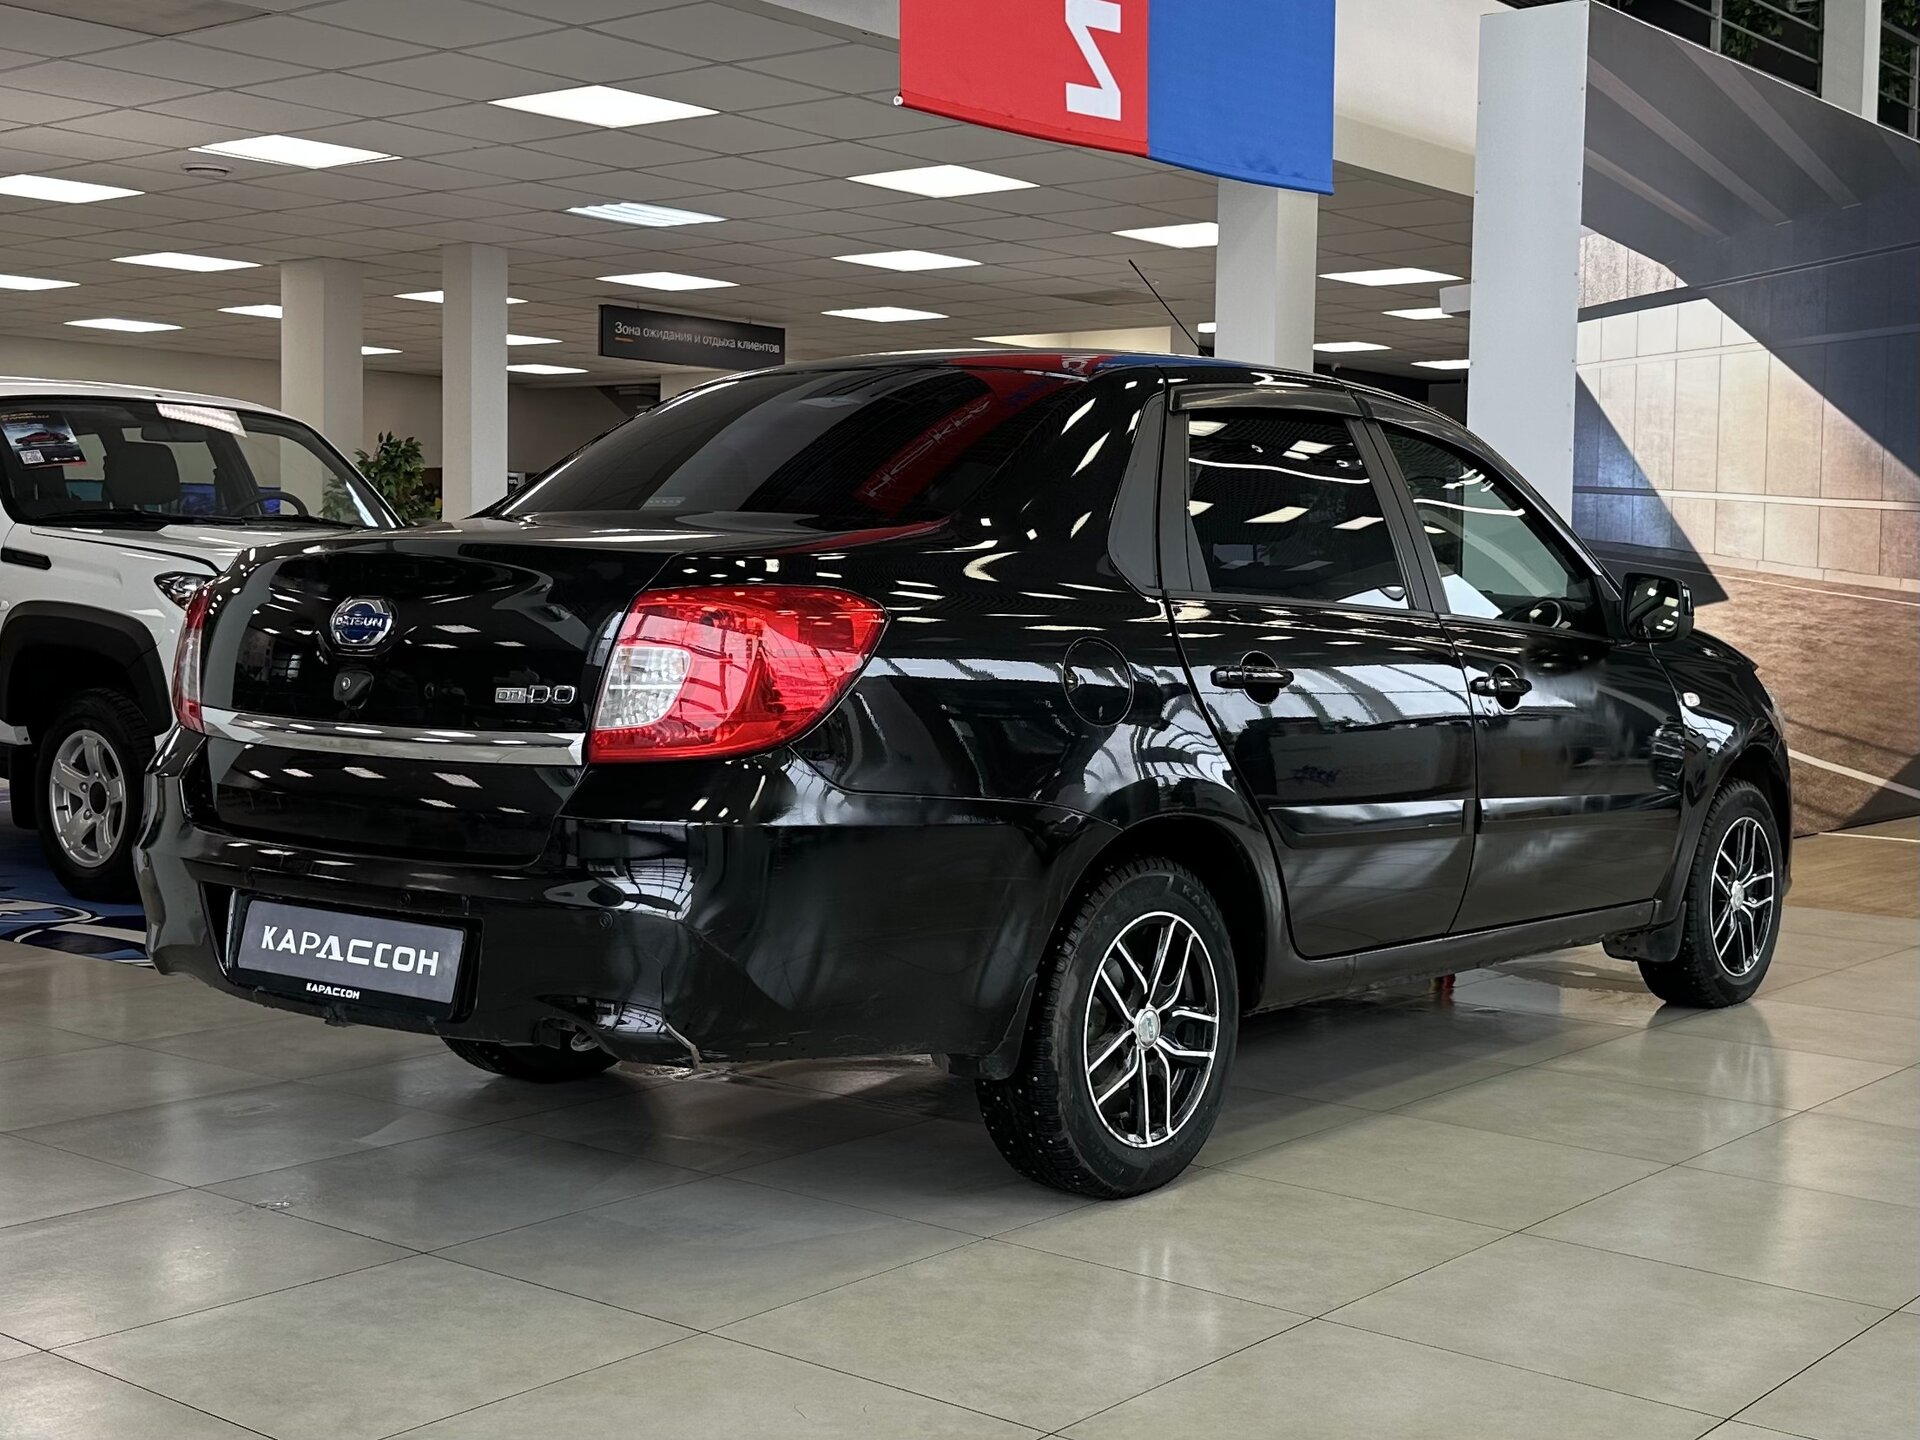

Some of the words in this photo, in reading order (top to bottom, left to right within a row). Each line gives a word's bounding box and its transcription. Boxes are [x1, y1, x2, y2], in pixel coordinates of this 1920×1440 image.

[615, 321, 641, 336] Зона
[643, 325, 693, 343] ожидания
[694, 334, 701, 343] и
[703, 336, 736, 348] отдыха
[737, 340, 780, 354] клиентов
[334, 614, 384, 629] DATSUN
[260, 925, 439, 977] КАРАССОН
[306, 982, 360, 1000] КАРАССОН
